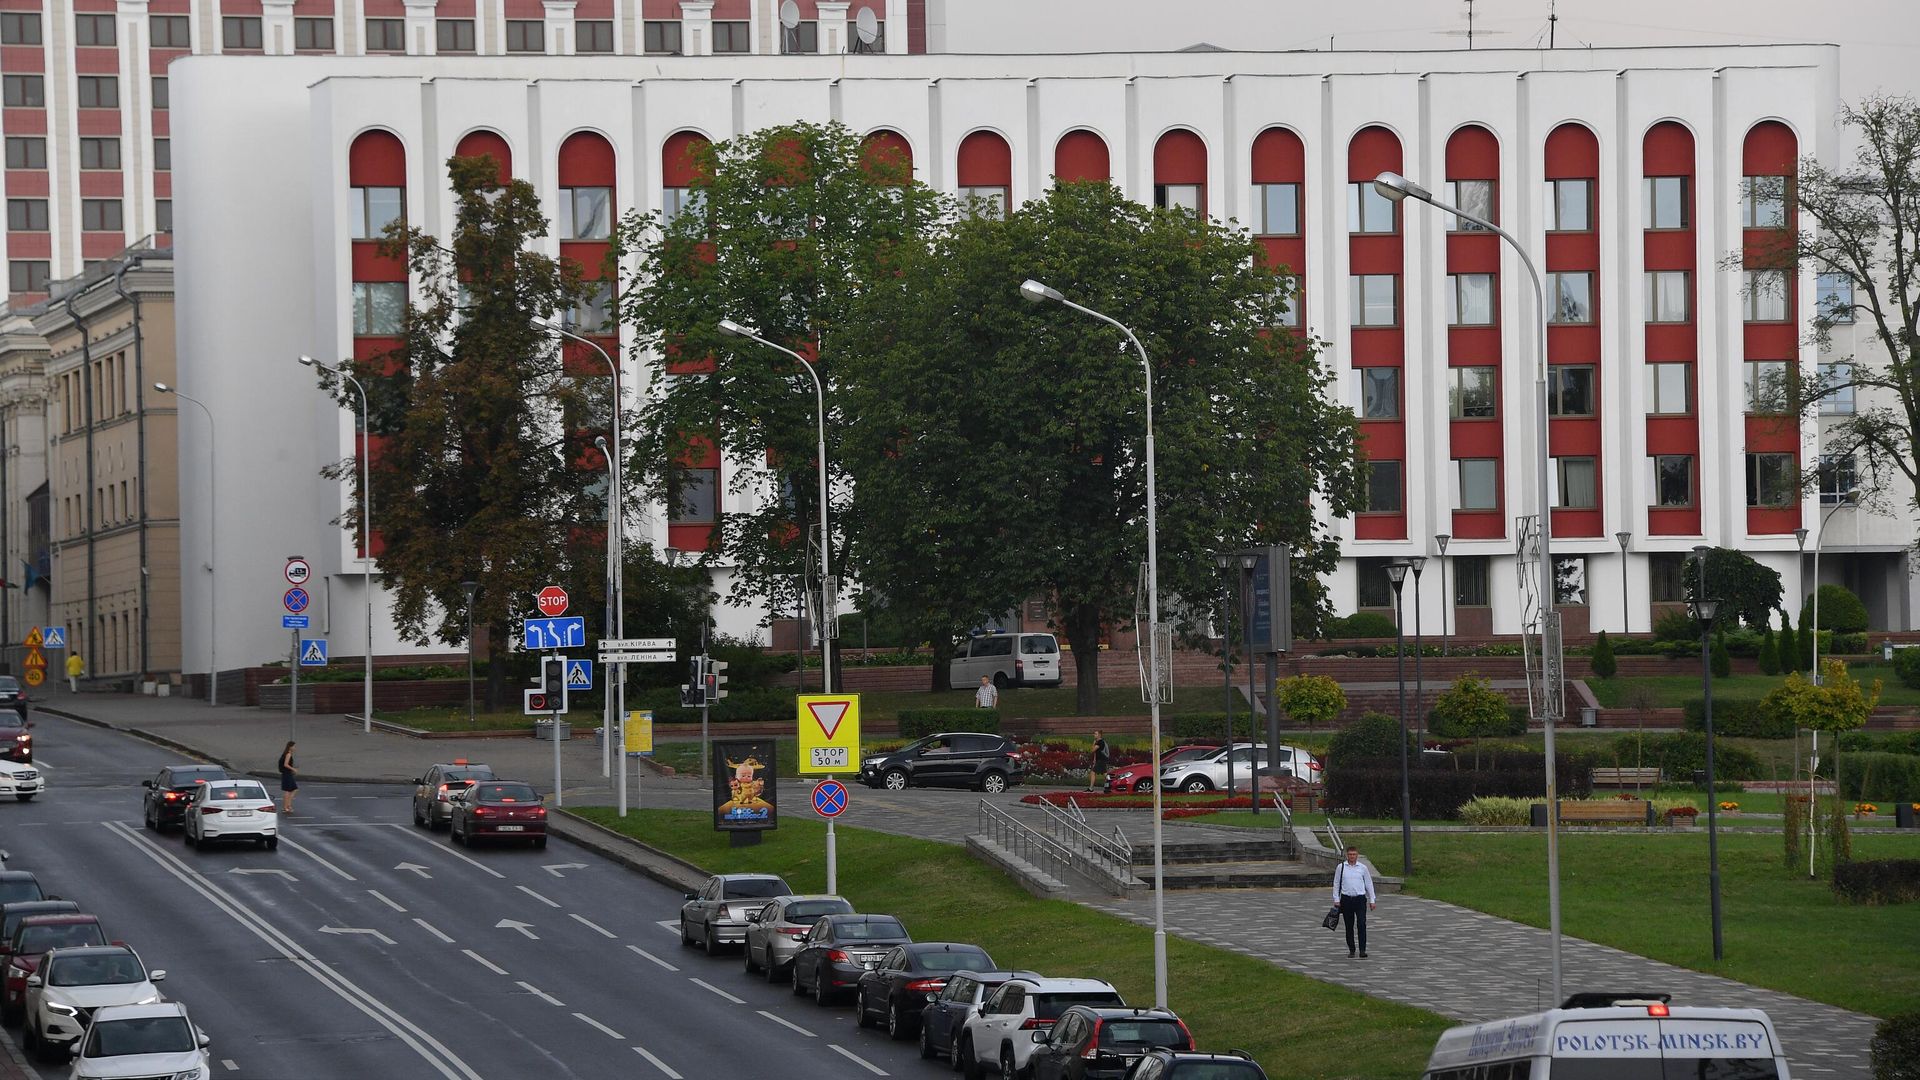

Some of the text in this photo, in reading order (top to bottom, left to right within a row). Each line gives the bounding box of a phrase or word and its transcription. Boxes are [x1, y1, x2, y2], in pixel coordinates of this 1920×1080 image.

[540, 596, 566, 607] STOP
[814, 748, 844, 757] STOP
[818, 757, 831, 766] 50
[1556, 1032, 1765, 1052] POLOTSK-MINSK.BY
